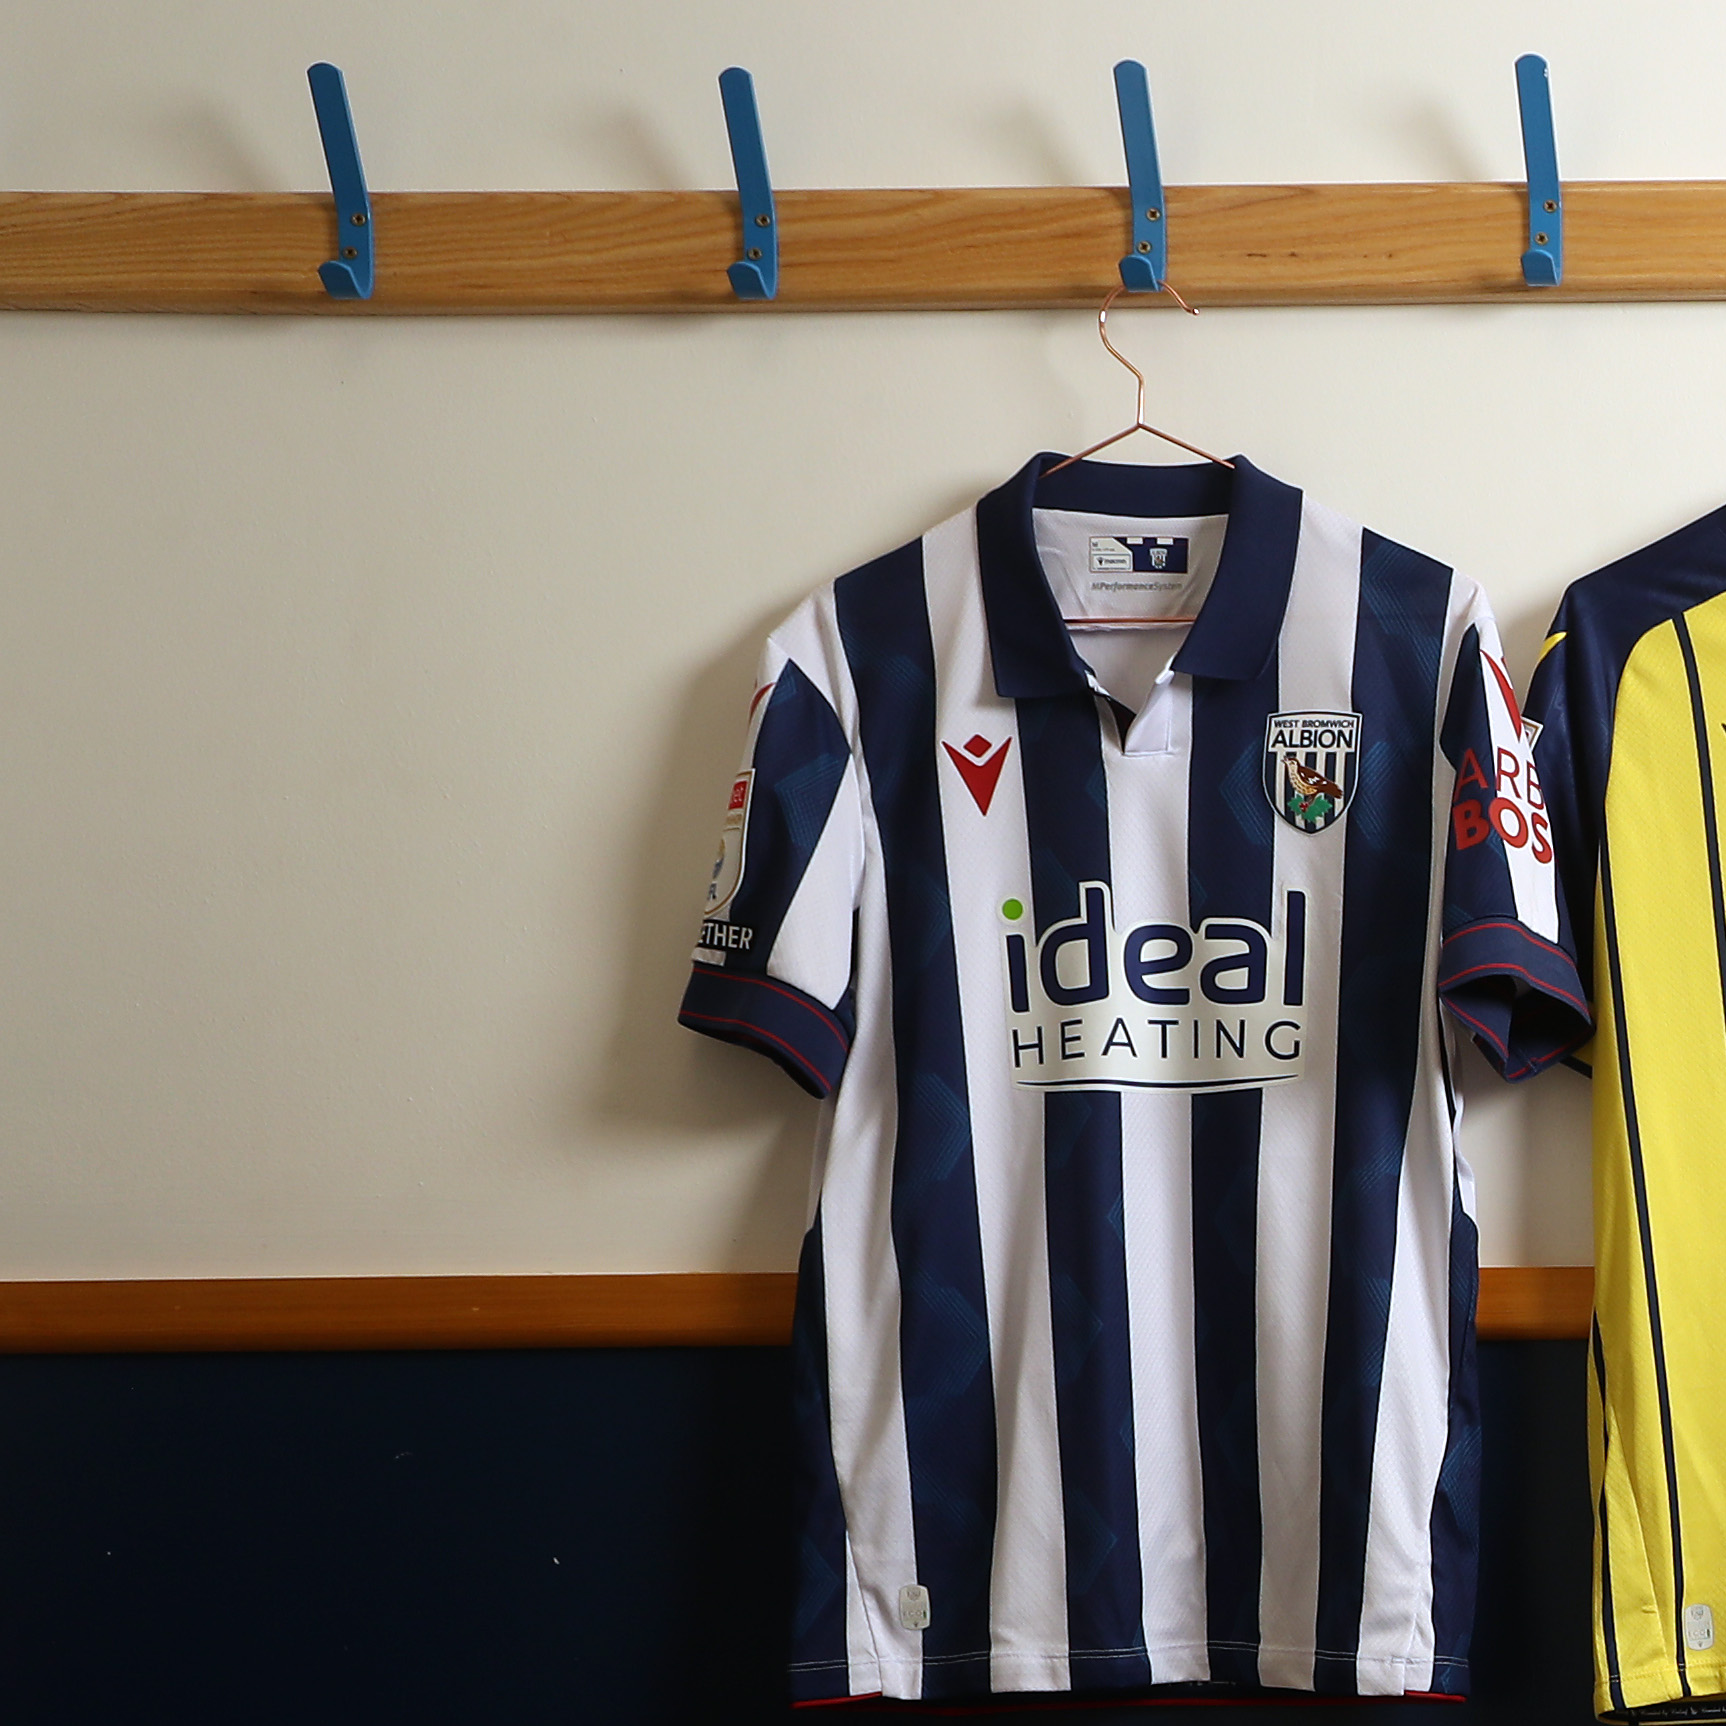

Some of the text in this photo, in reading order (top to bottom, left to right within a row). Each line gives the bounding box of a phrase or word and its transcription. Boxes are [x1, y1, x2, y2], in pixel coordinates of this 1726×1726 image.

[1271, 729, 1353, 748] ALBION
[1274, 719, 1354, 728] WEST BROMWICH
[1002, 887, 1306, 1012] ideal
[1013, 1018, 1302, 1067] HEATING
